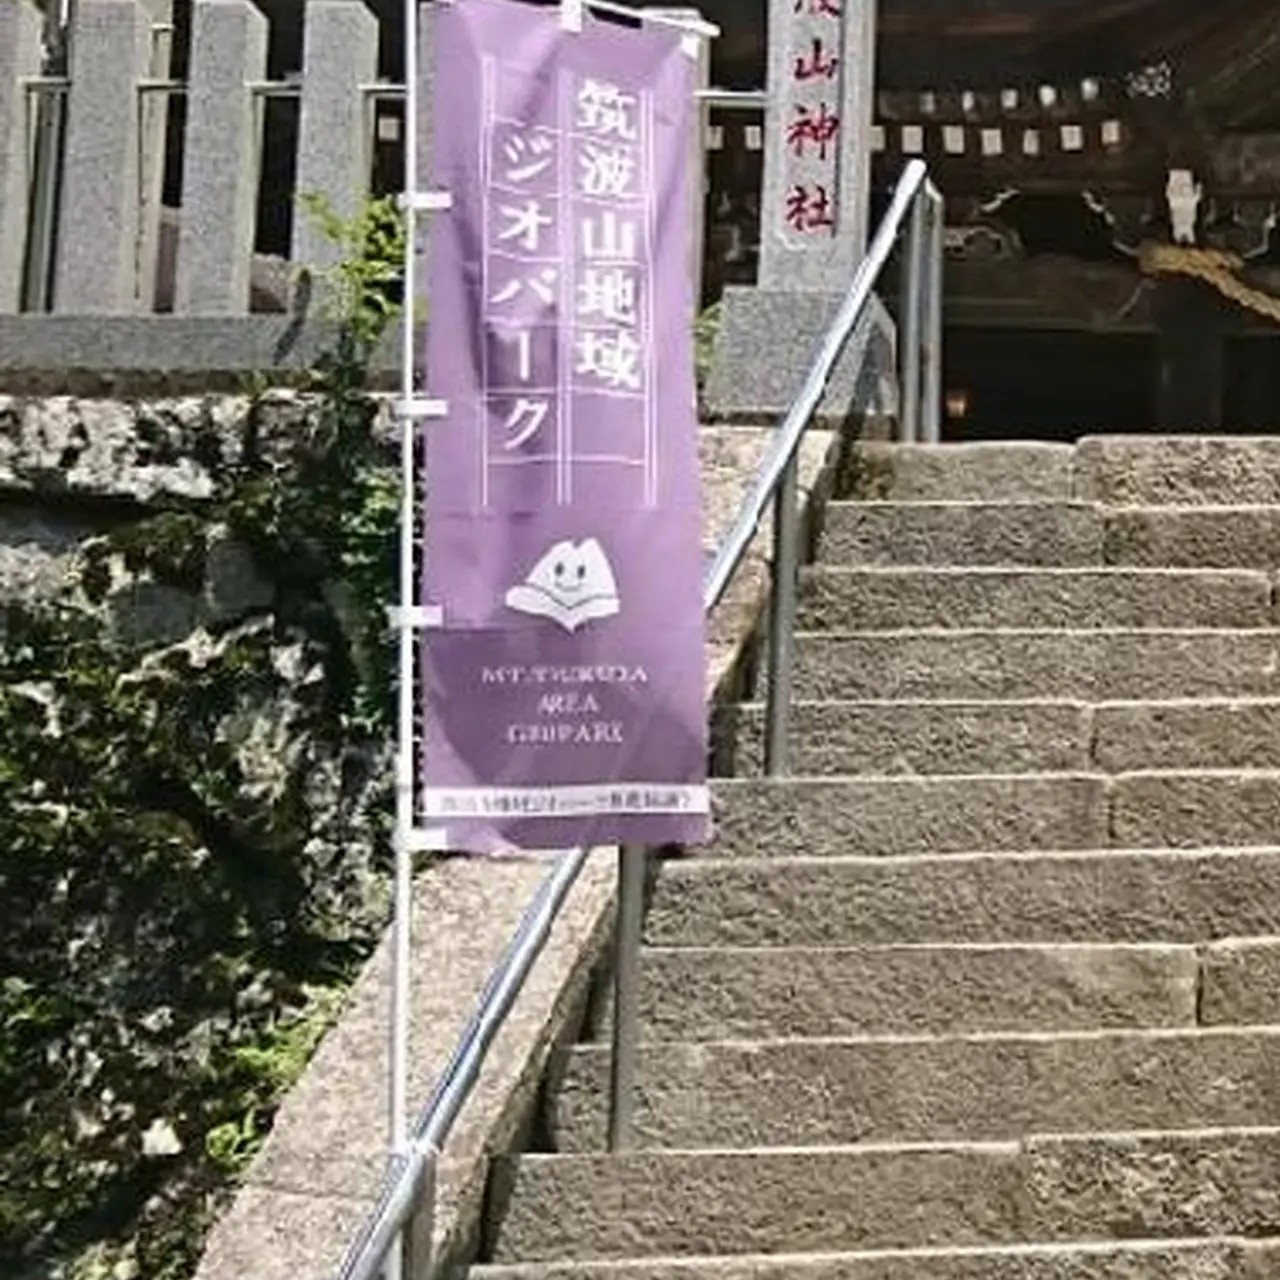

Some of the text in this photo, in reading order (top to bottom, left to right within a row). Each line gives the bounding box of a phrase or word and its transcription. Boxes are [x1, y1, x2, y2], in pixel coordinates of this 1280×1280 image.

[489, 134, 560, 451] ジオパーク
[576, 78, 641, 389] 筑波山地域
